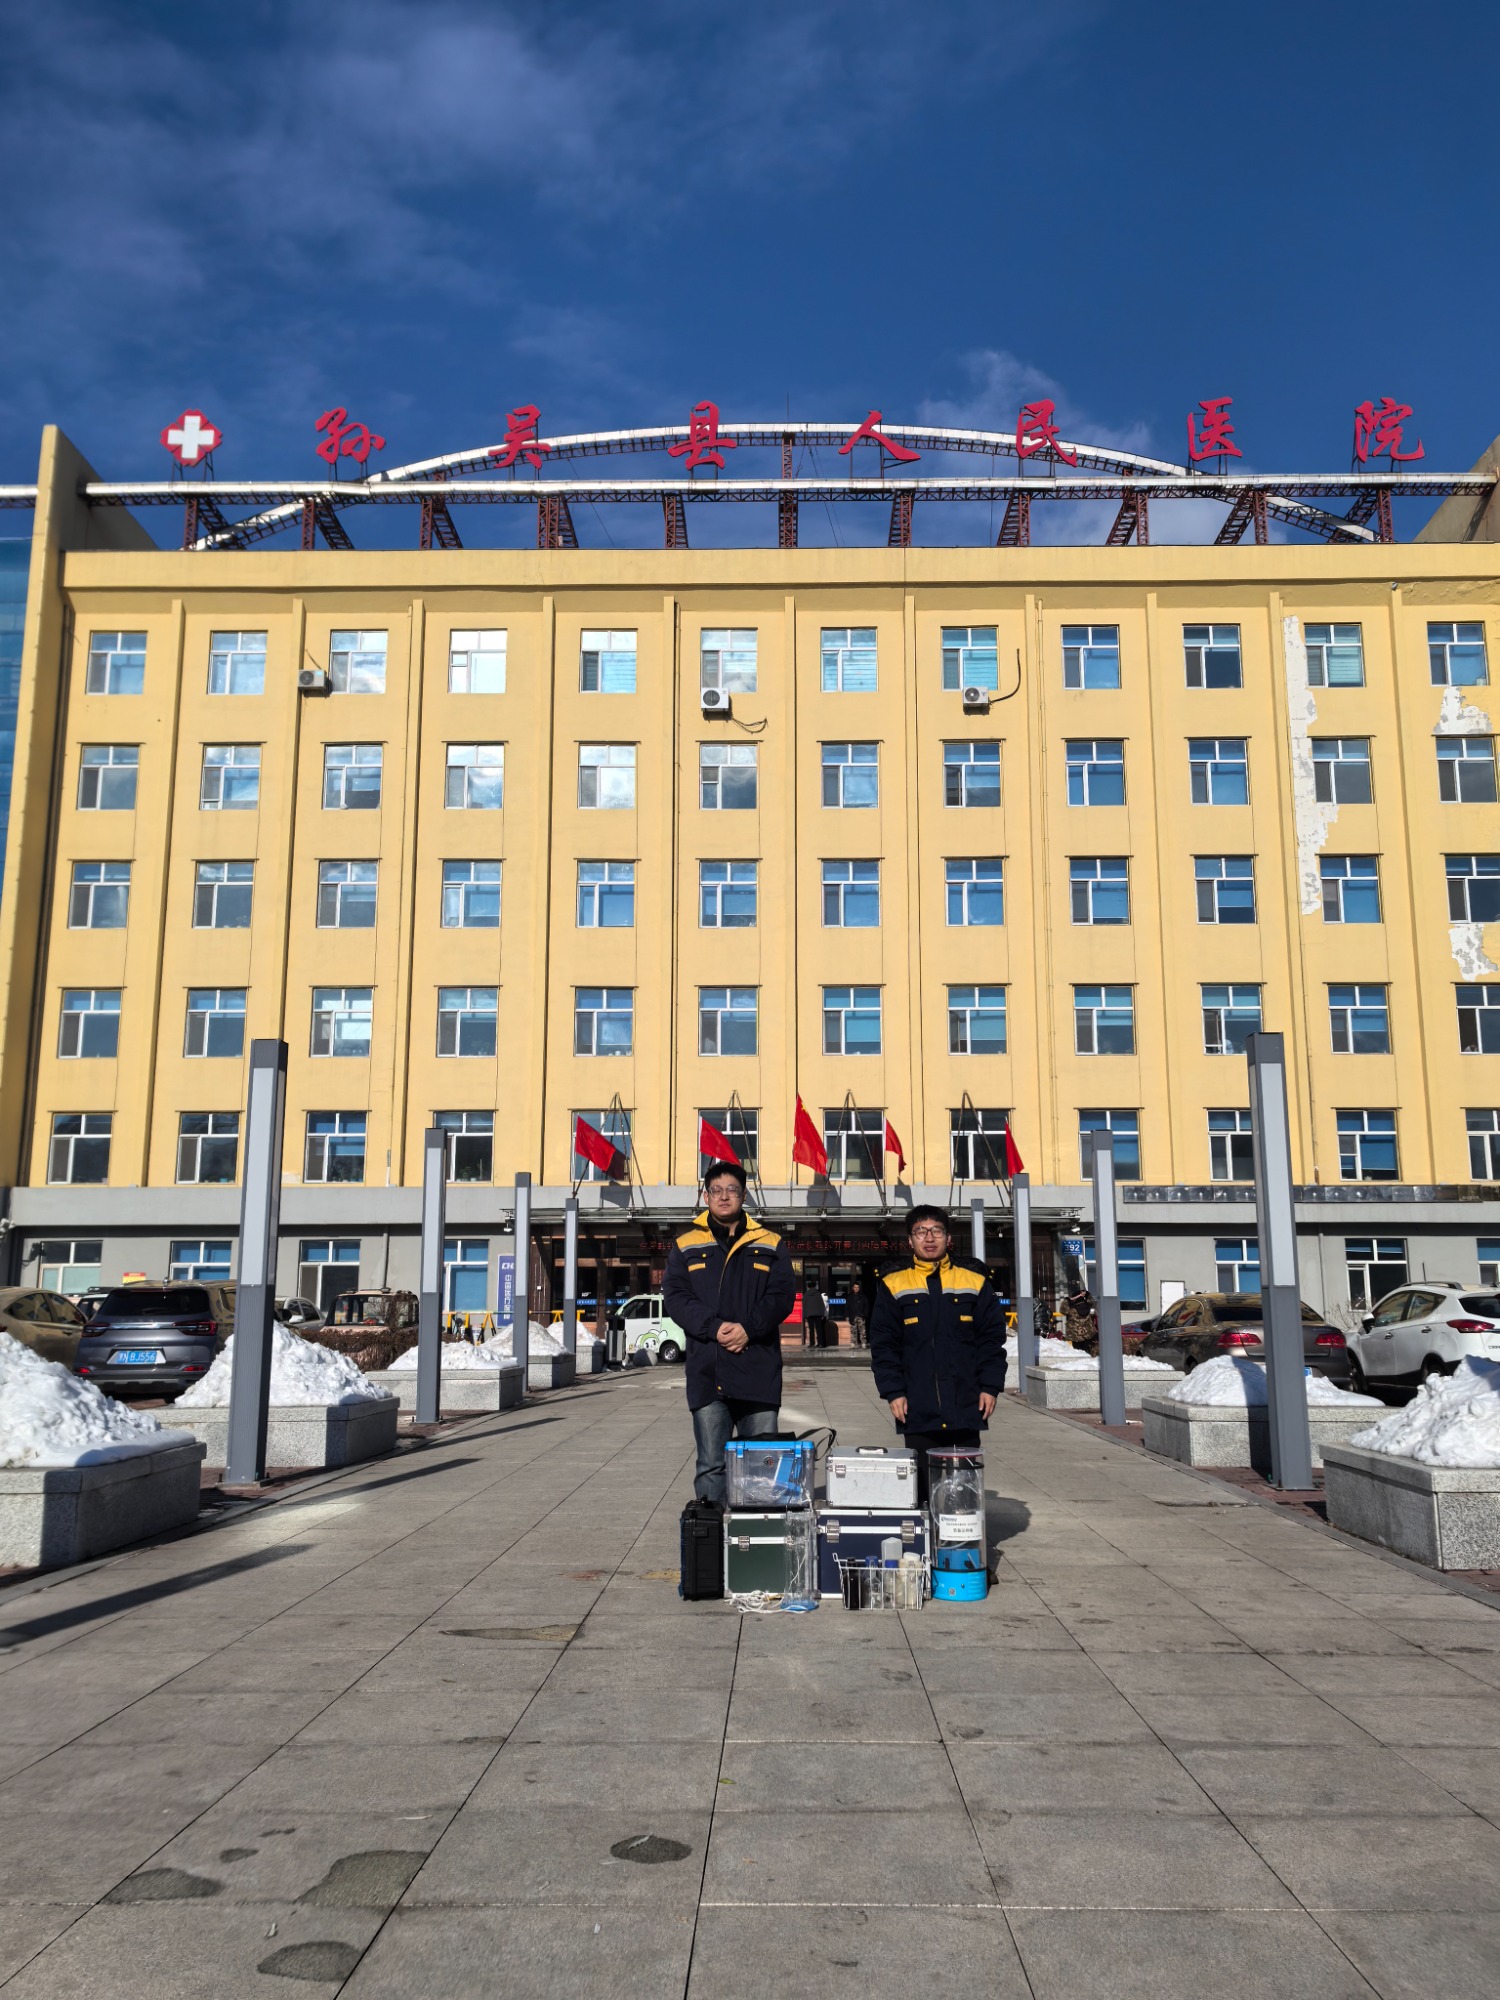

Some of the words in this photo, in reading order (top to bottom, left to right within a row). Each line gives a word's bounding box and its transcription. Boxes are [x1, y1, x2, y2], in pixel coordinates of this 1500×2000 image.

[316, 396, 1425, 470] 孙吴县人民医院
